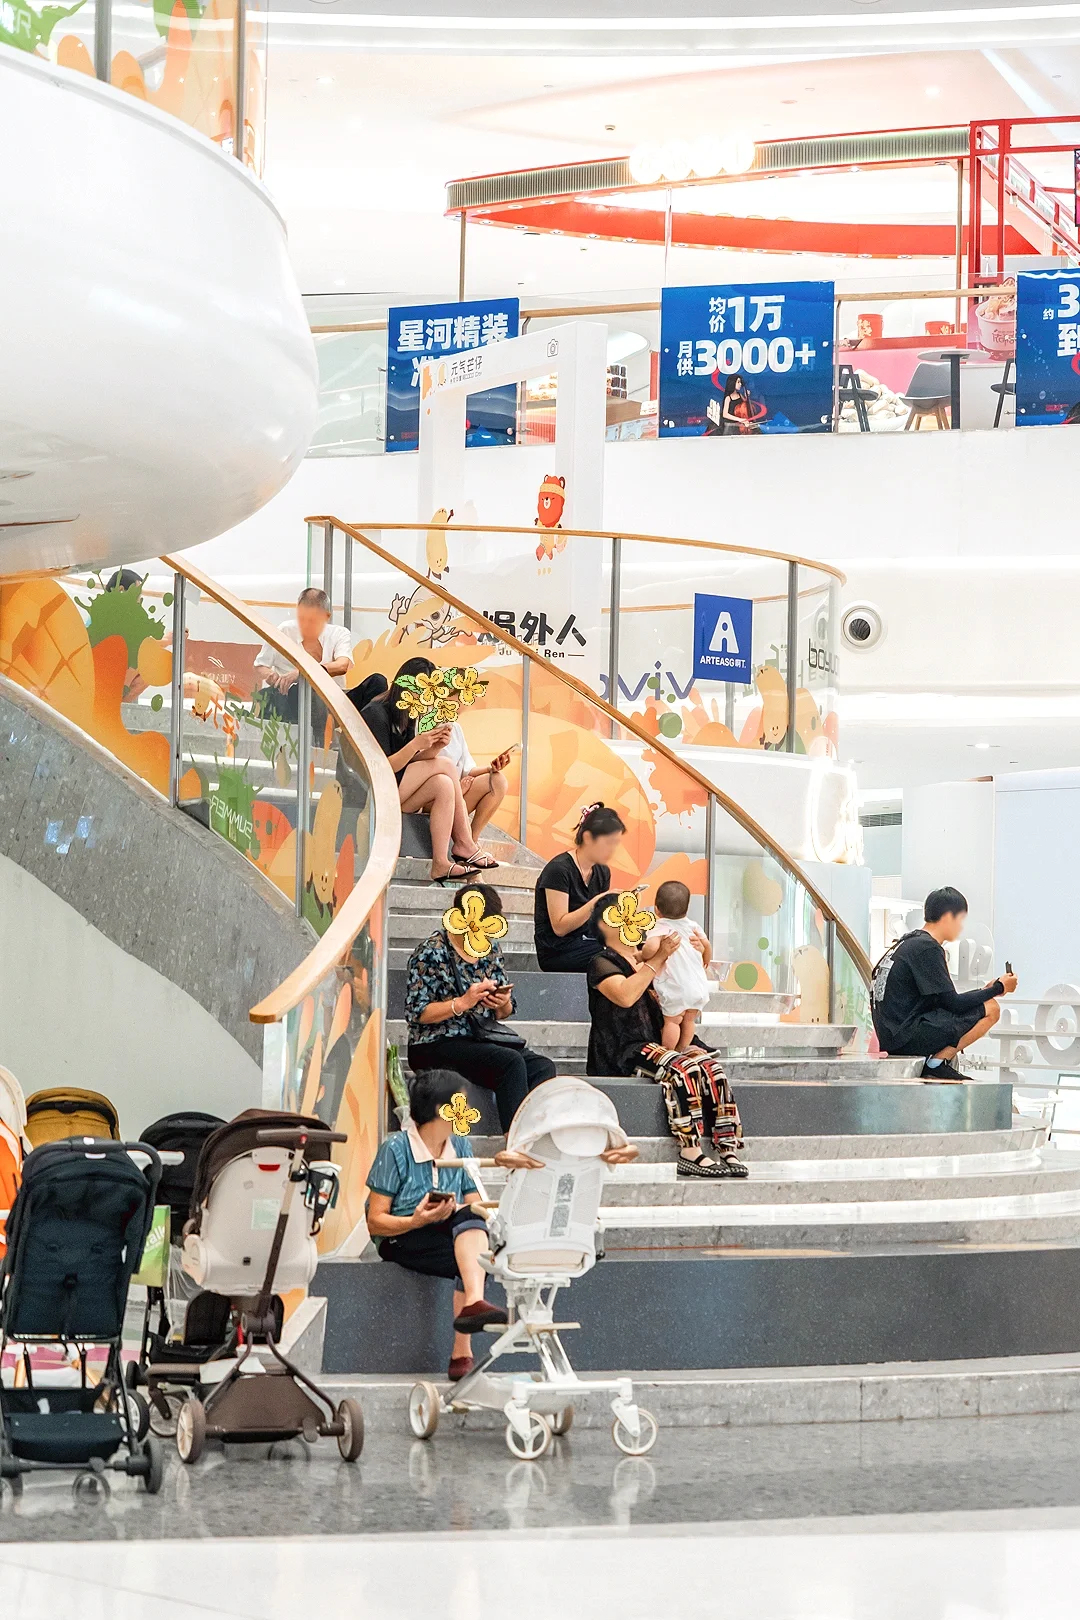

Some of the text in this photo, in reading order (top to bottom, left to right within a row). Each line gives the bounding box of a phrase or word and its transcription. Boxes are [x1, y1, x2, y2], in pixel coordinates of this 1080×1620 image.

[397, 312, 509, 352] 星河精装
[451, 355, 483, 377] 元气芒仔
[544, 648, 565, 658] Ren
